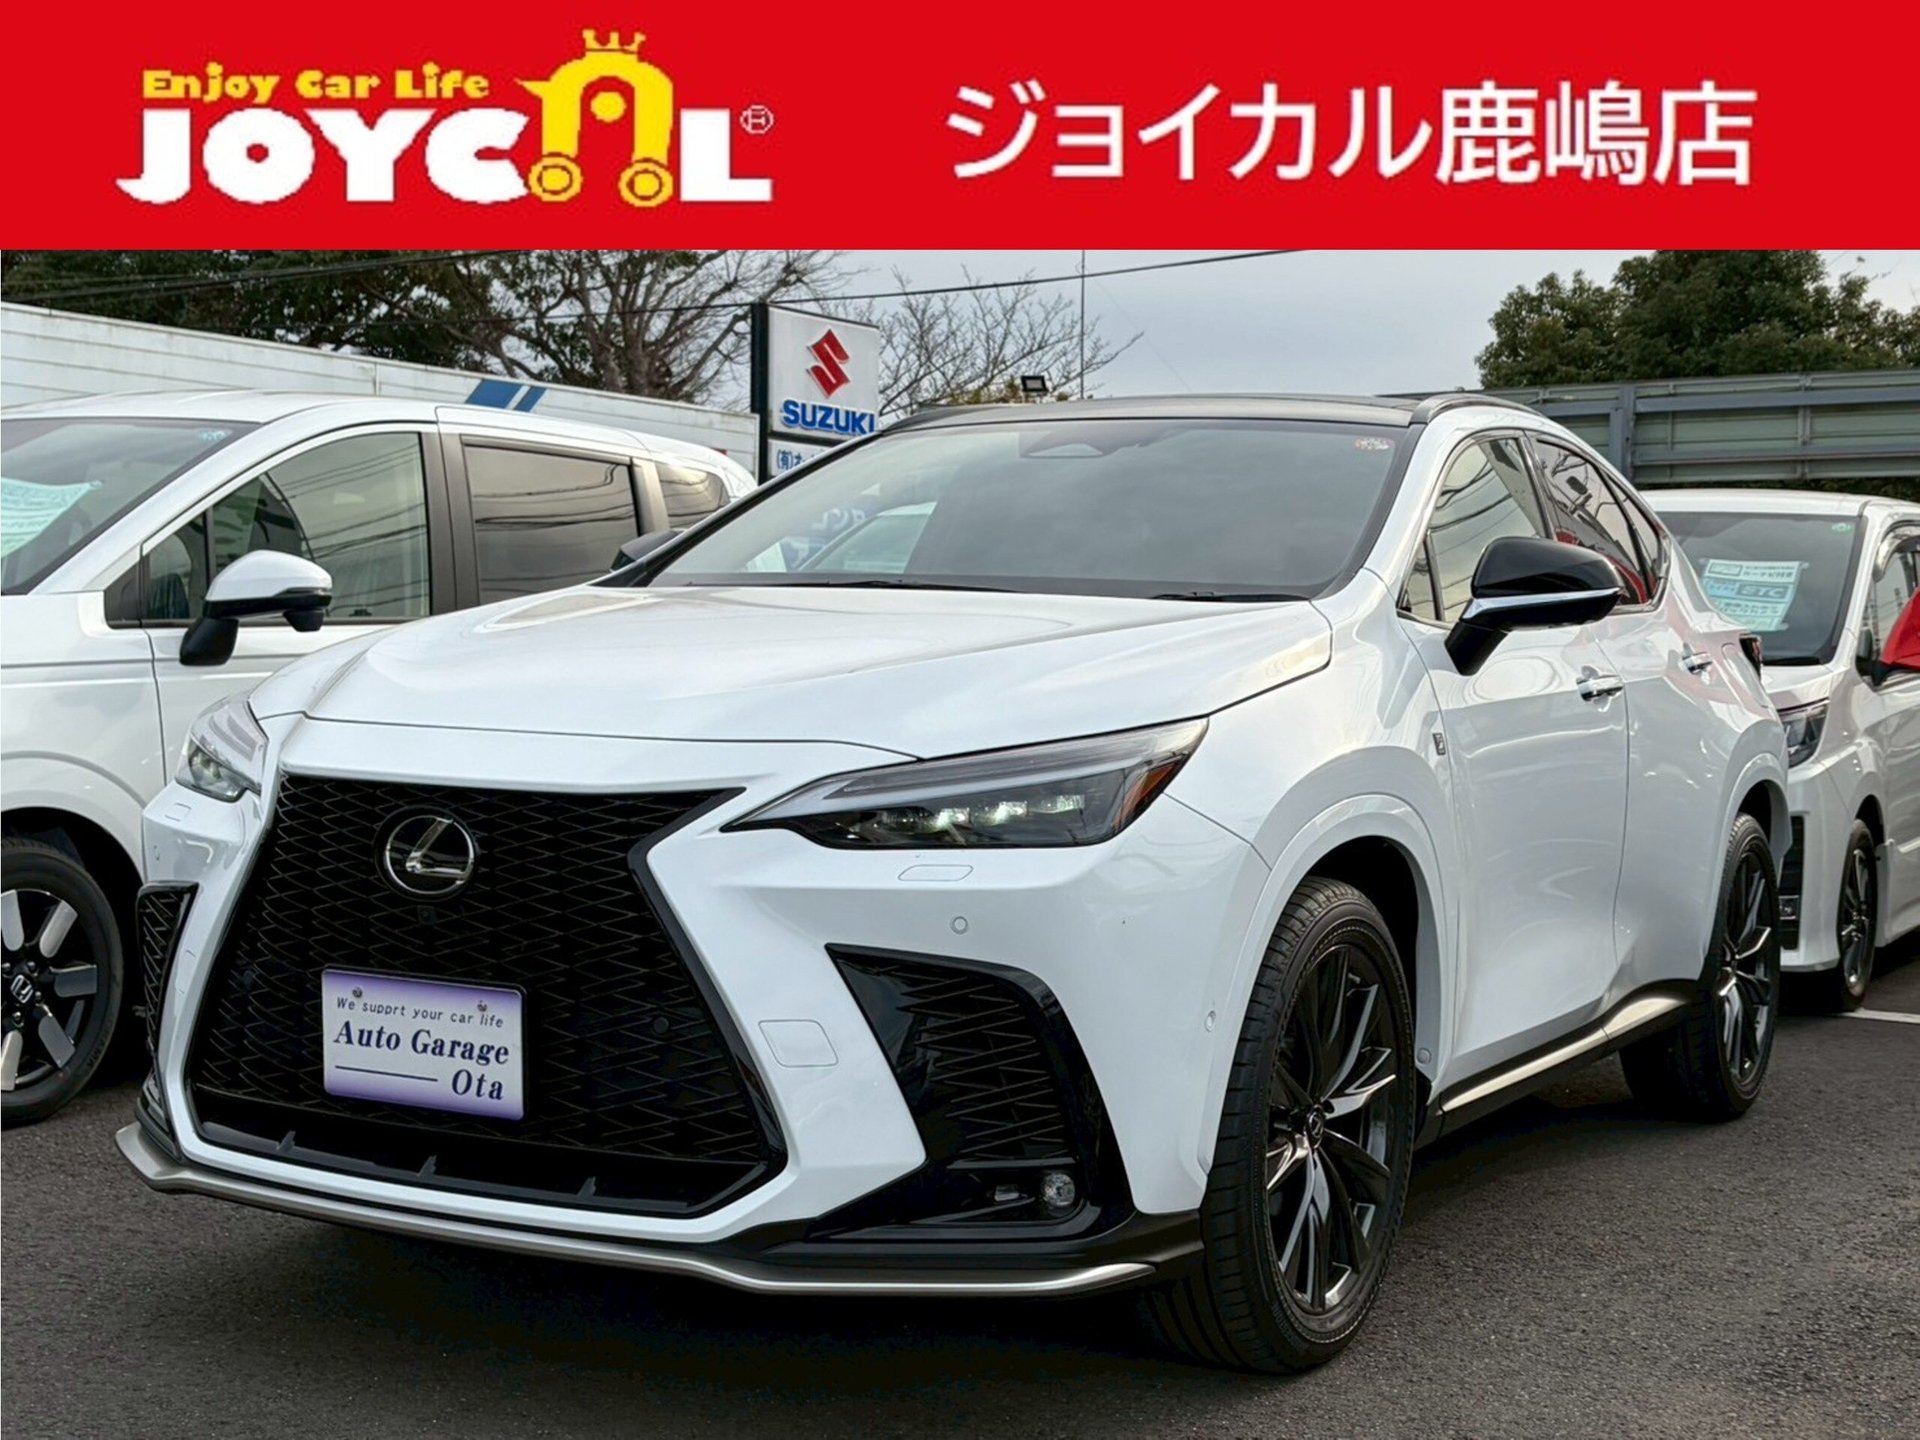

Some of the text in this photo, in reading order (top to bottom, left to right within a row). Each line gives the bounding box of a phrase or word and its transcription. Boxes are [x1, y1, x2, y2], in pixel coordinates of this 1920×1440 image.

[782, 399, 876, 435] SUZUKI
[336, 996, 355, 1011] We
[412, 1008, 444, 1021] your
[450, 1011, 474, 1025] car
[480, 1013, 504, 1028] life
[333, 1020, 509, 1066] Auto Garage
[452, 1069, 504, 1100] Ota
